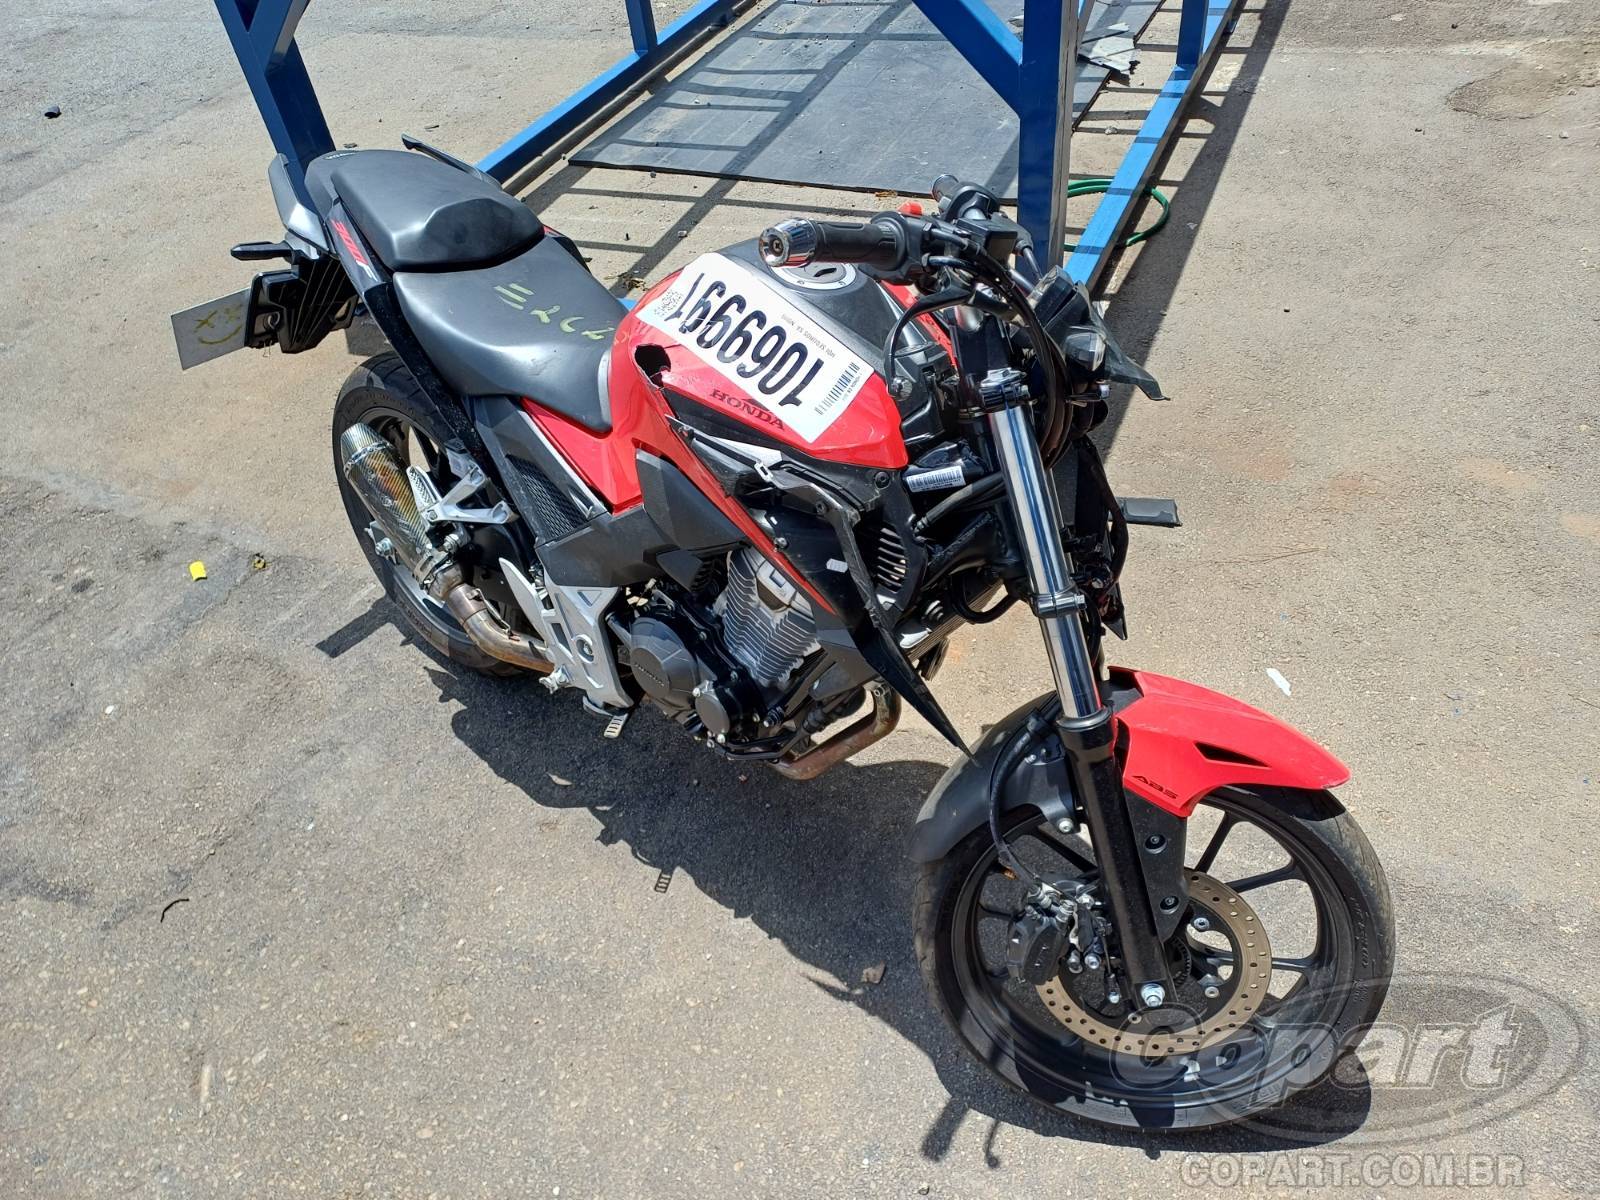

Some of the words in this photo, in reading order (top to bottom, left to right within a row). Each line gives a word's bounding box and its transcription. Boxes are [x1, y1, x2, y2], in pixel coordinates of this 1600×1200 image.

[663, 272, 824, 407] 1069991
[709, 389, 786, 430] HONDA
[1131, 775, 1179, 800] ABS
